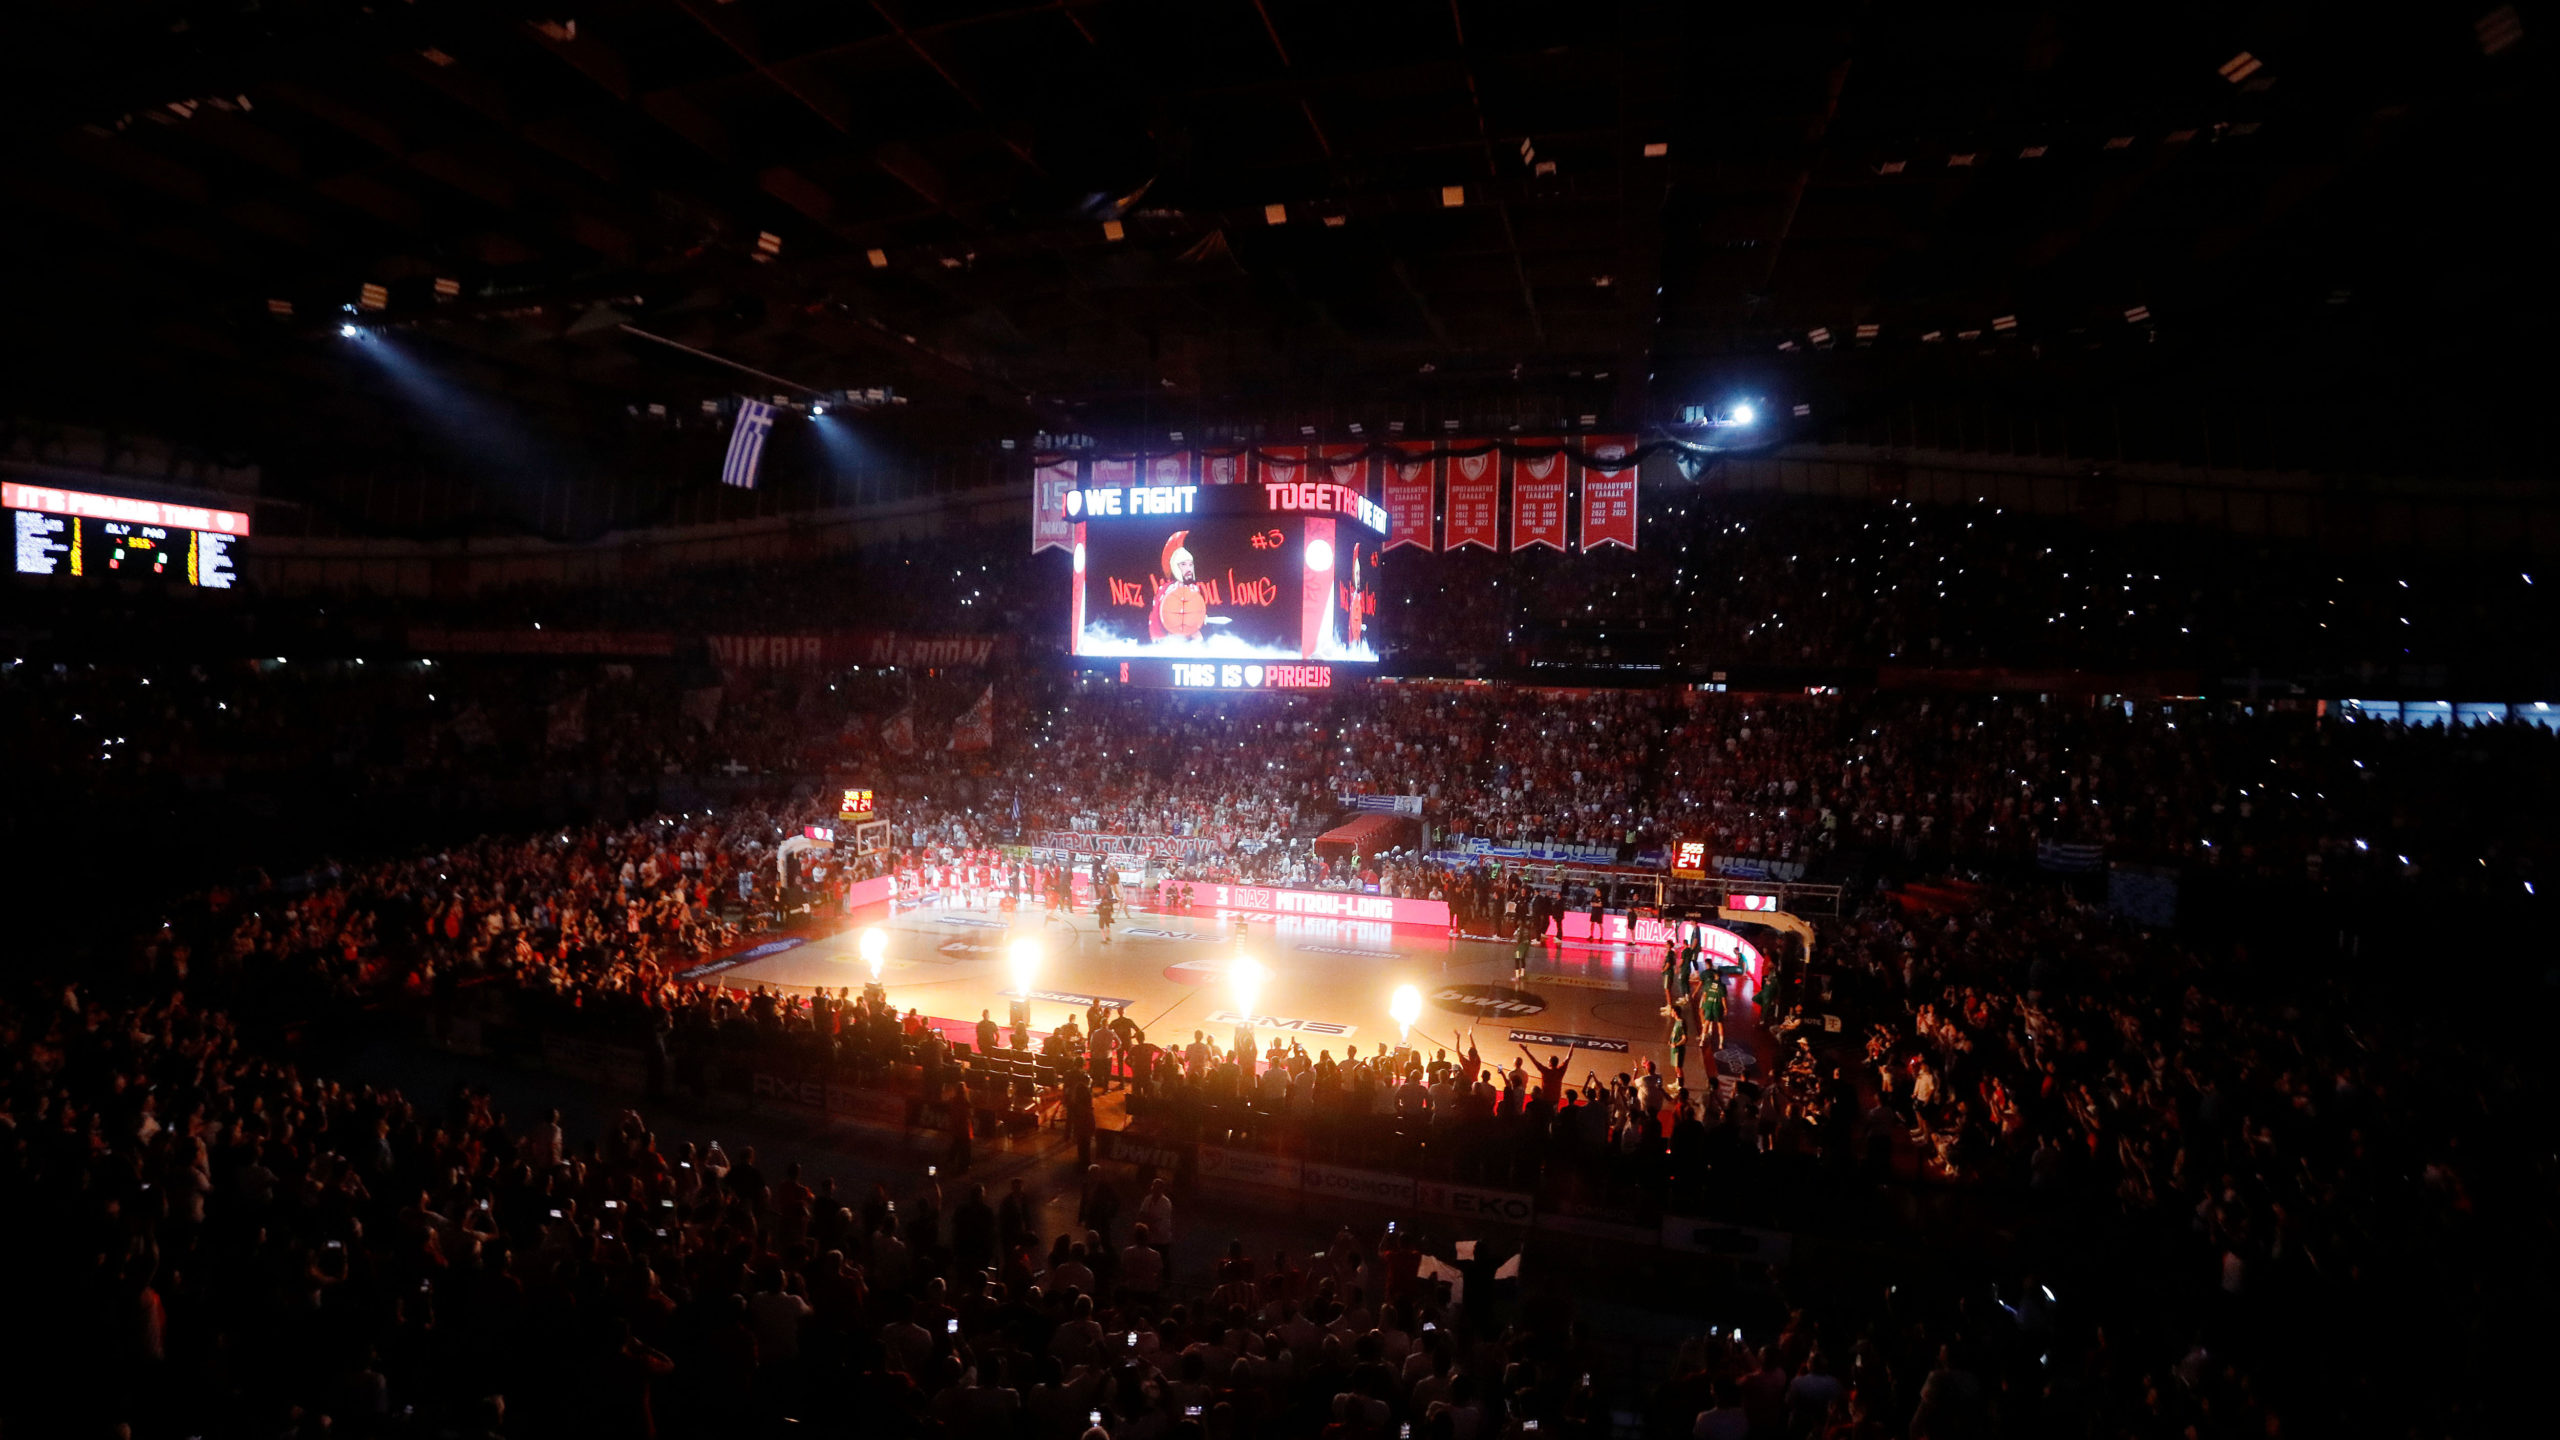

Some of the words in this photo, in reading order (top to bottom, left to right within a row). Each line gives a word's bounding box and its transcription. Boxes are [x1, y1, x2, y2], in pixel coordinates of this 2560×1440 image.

[1085, 488, 1122, 515] WE
[1129, 486, 1198, 515] FIGHT
[1265, 482, 1358, 518] TOGETHER
[1251, 529, 1285, 550] #3
[1172, 664, 1215, 687] THIS
[1221, 664, 1242, 688] IS
[842, 798, 858, 812] 24
[1677, 854, 1702, 868] 24
[1216, 887, 1228, 905] 3
[1234, 888, 1270, 909] NAZ
[1276, 891, 1393, 919] MITROU-LONG
[1612, 918, 1628, 938] 3
[1431, 990, 1543, 1014] bwin
[1510, 1032, 1553, 1043] NBG
[1587, 1040, 1627, 1050] PAY
[1452, 1192, 1530, 1220] EKO
